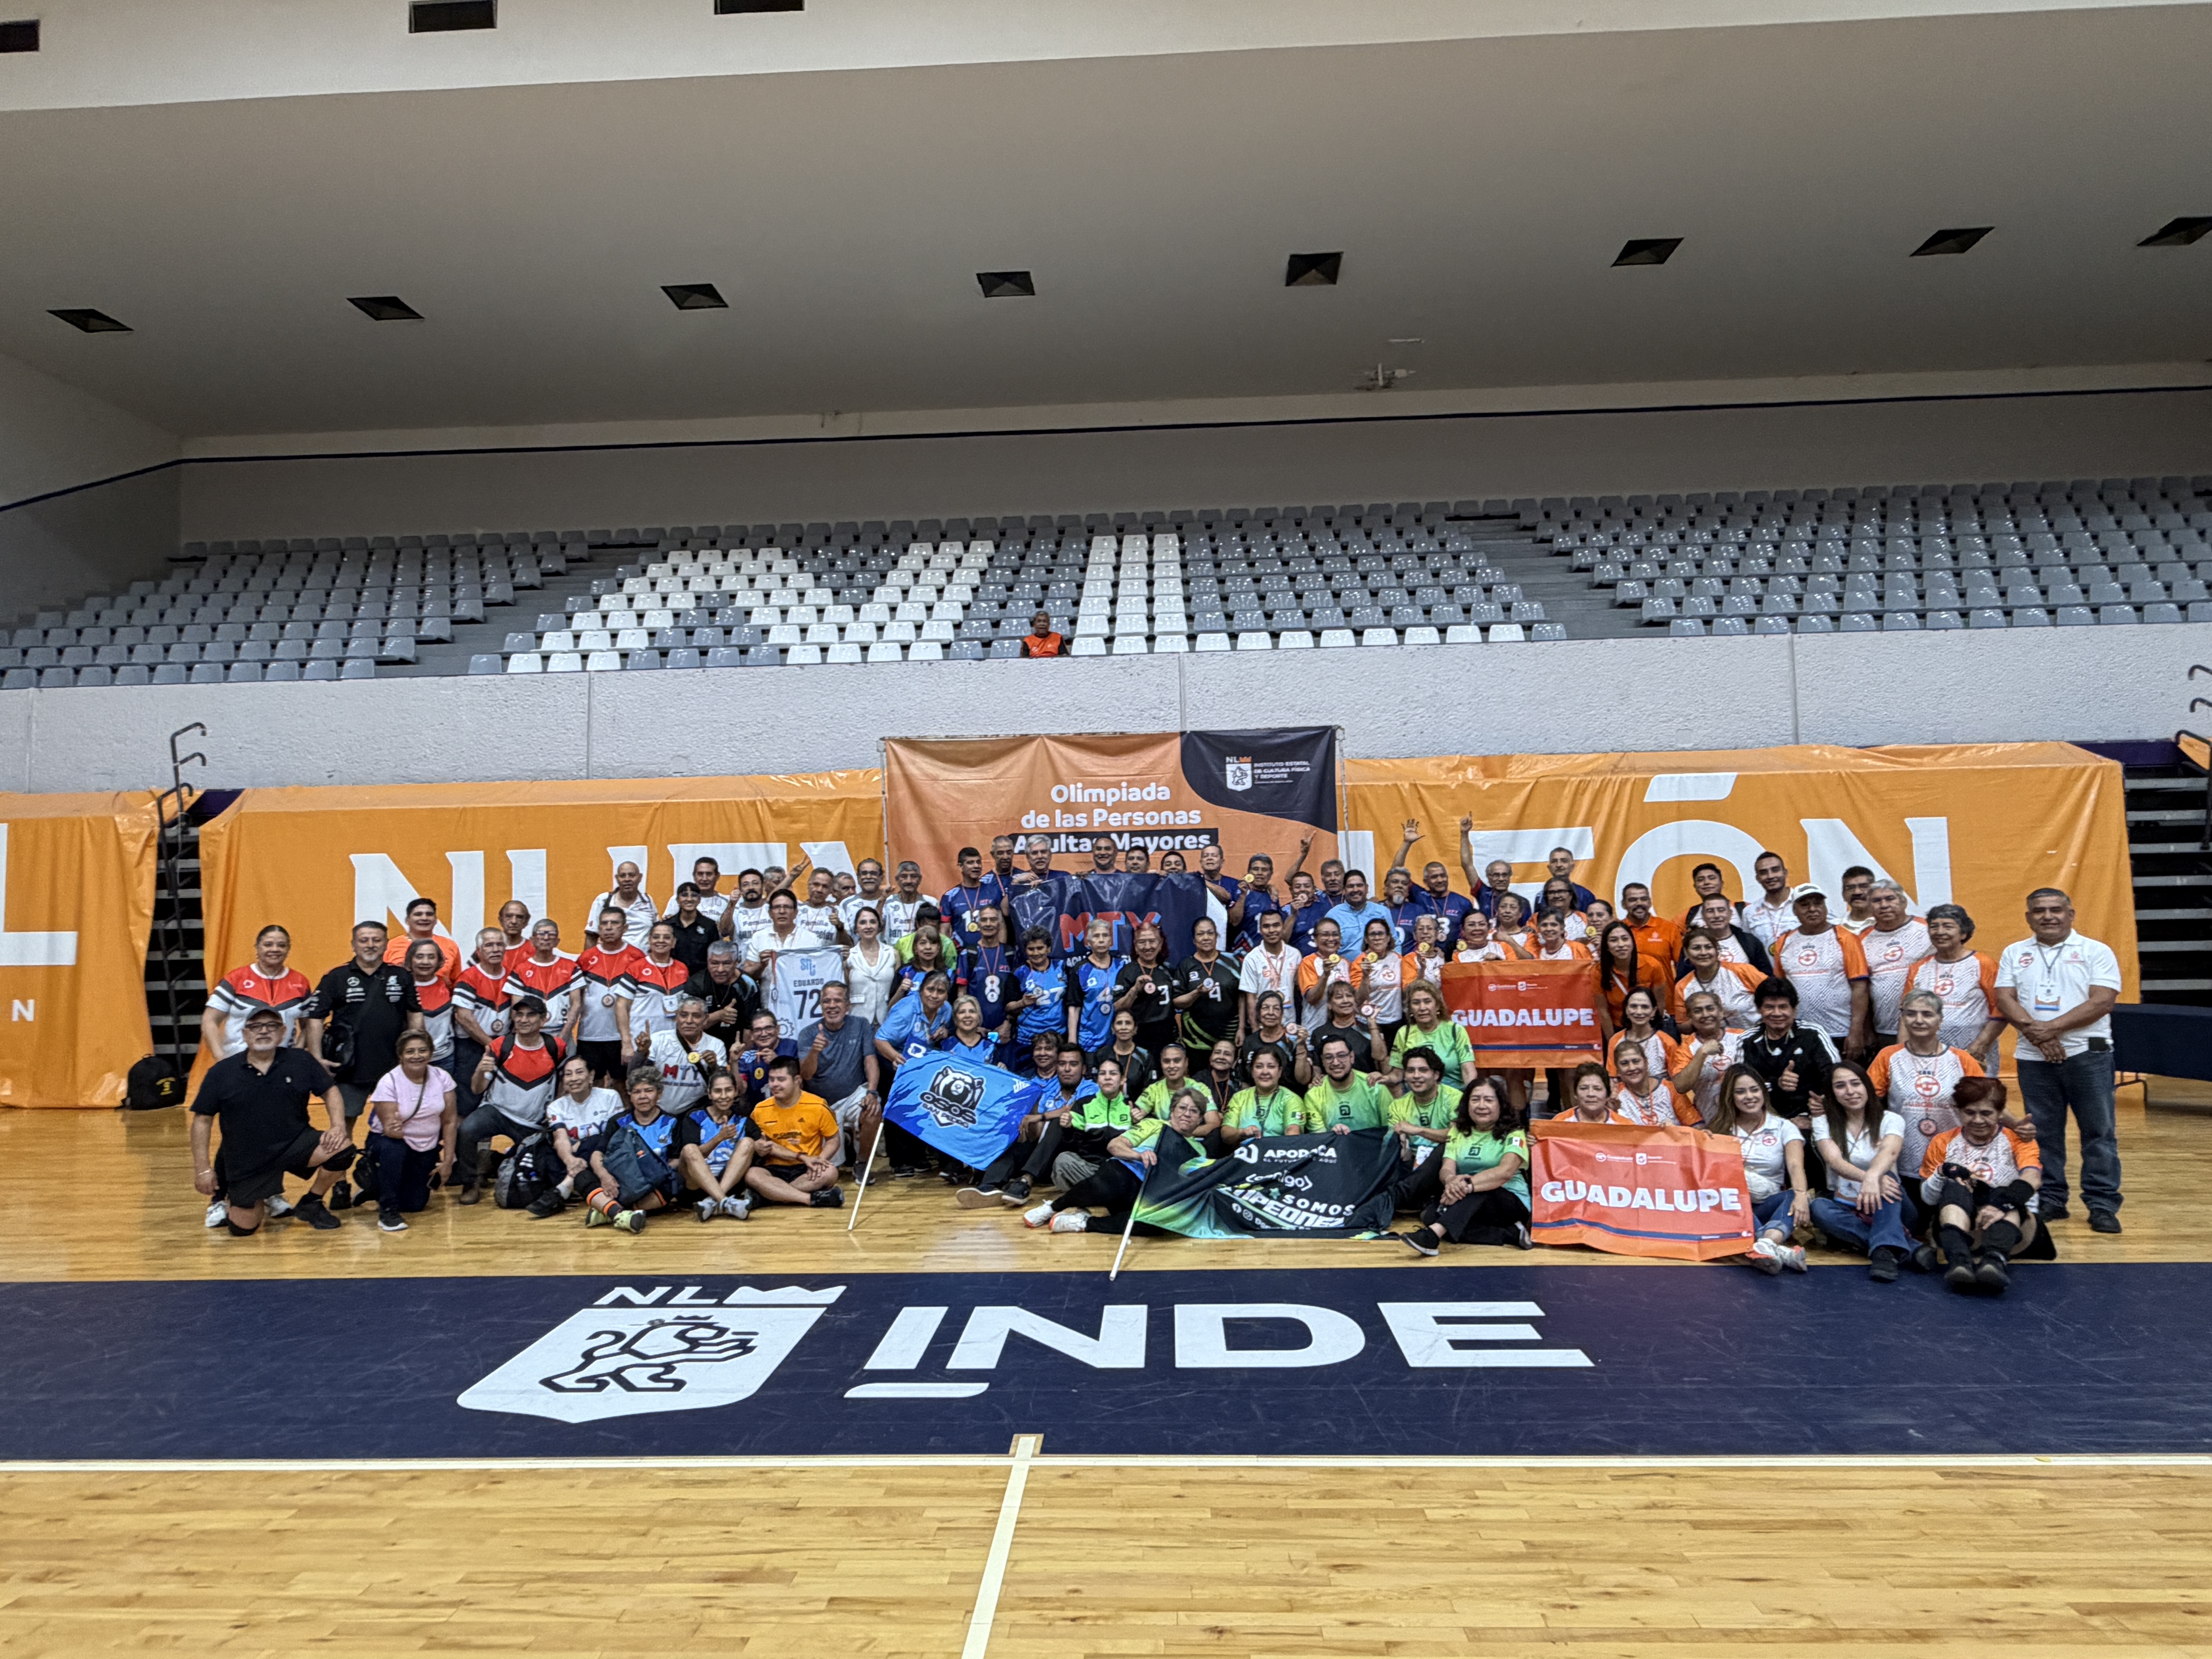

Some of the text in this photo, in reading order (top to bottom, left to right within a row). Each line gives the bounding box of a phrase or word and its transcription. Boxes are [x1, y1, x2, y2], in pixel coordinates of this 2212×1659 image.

[1051, 782, 1170, 806] Olimpiada
[1021, 808, 1201, 829] de las Personas
[1014, 832, 1210, 854] Aulta Mayores
[1060, 912, 1161, 953] MTY
[794, 978, 824, 987] EDUARDO
[1036, 987, 1065, 1006] 27
[1097, 987, 1113, 1002] 4
[1158, 985, 1170, 1005] 3
[1209, 986, 1221, 1002] 4
[793, 989, 823, 1020] 72
[1451, 1008, 1595, 1027] GUADALUPE
[663, 1063, 698, 1080] MTY
[920, 1092, 977, 1124] OSOS
[922, 1103, 940, 1115] SAN
[941, 1113, 969, 1128] PEDRO
[1282, 1194, 1355, 1216] SOMOS
[1541, 1180, 1741, 1212] GUADALUPE
[592, 1286, 718, 1305] NL
[864, 1302, 1595, 1370] INDE
